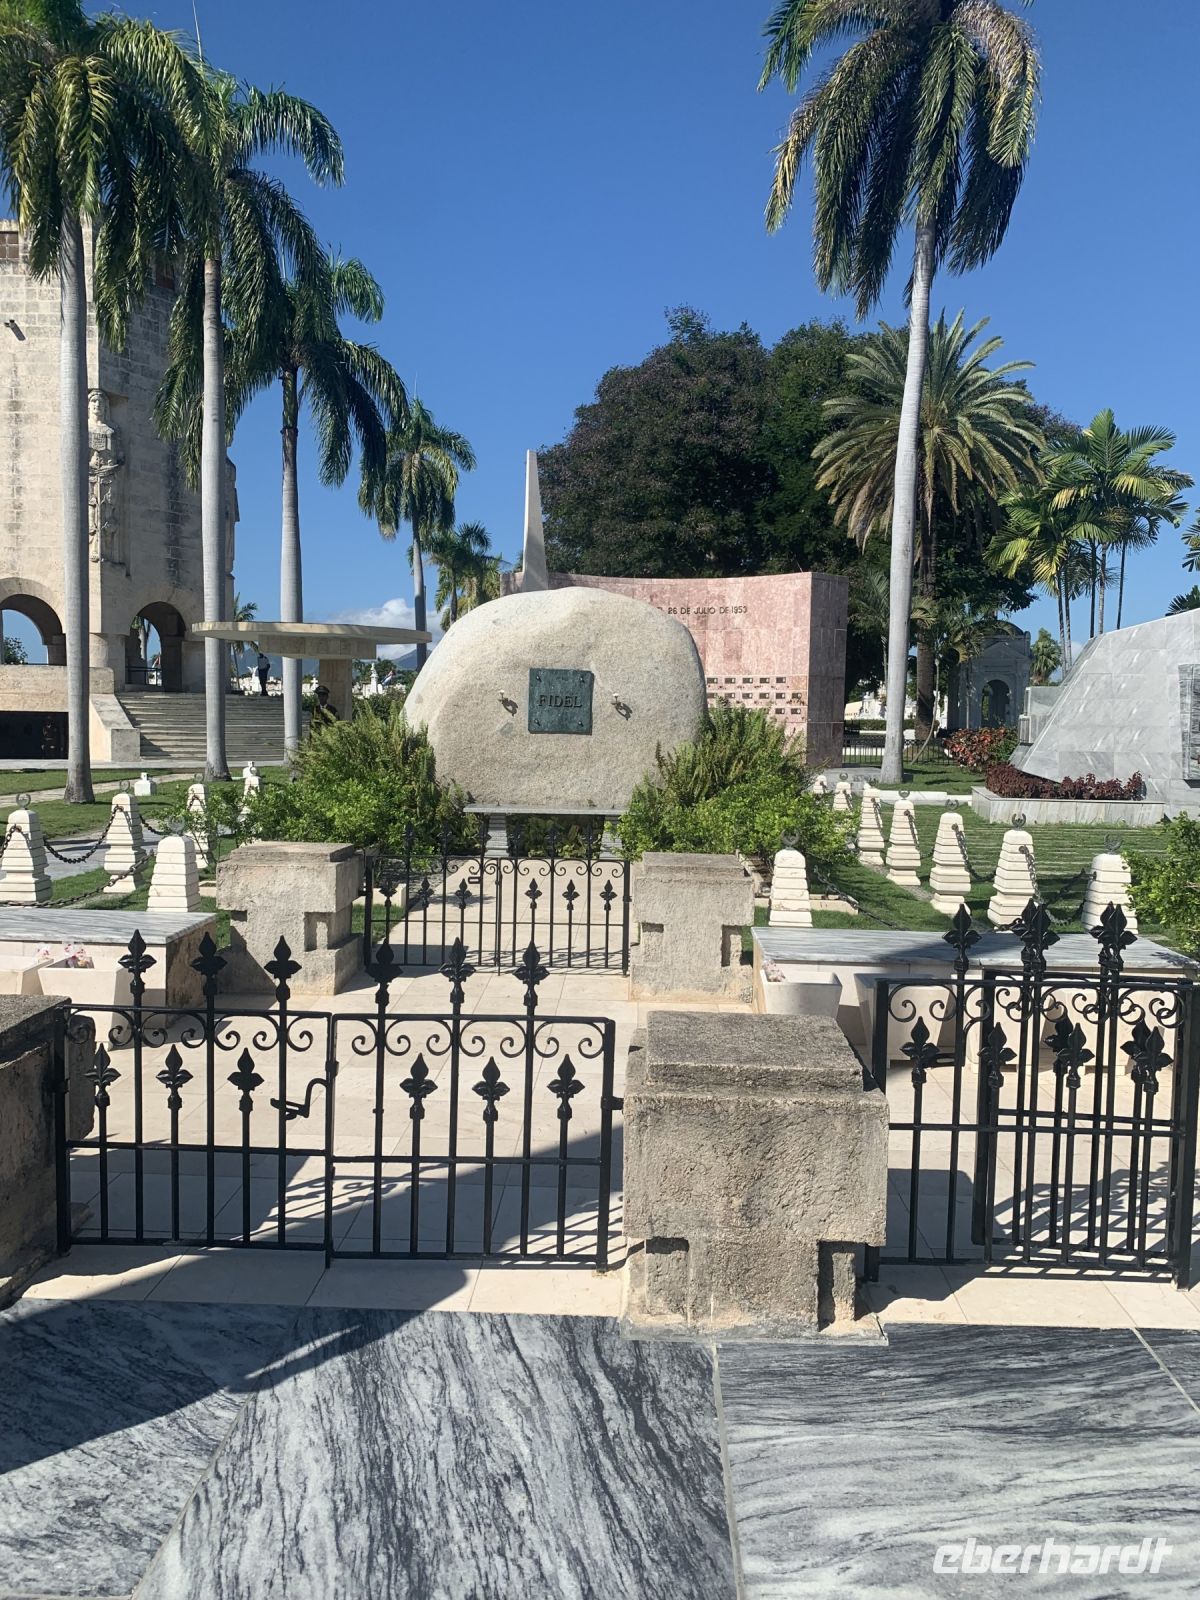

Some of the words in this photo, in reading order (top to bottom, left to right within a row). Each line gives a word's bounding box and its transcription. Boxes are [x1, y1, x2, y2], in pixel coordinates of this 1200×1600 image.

[667, 607, 678, 615] 26
[680, 607, 691, 615] DE
[693, 606, 716, 615] JULIO
[719, 606, 729, 614] DE
[731, 605, 748, 614] 1953
[538, 694, 583, 708] FIDEL
